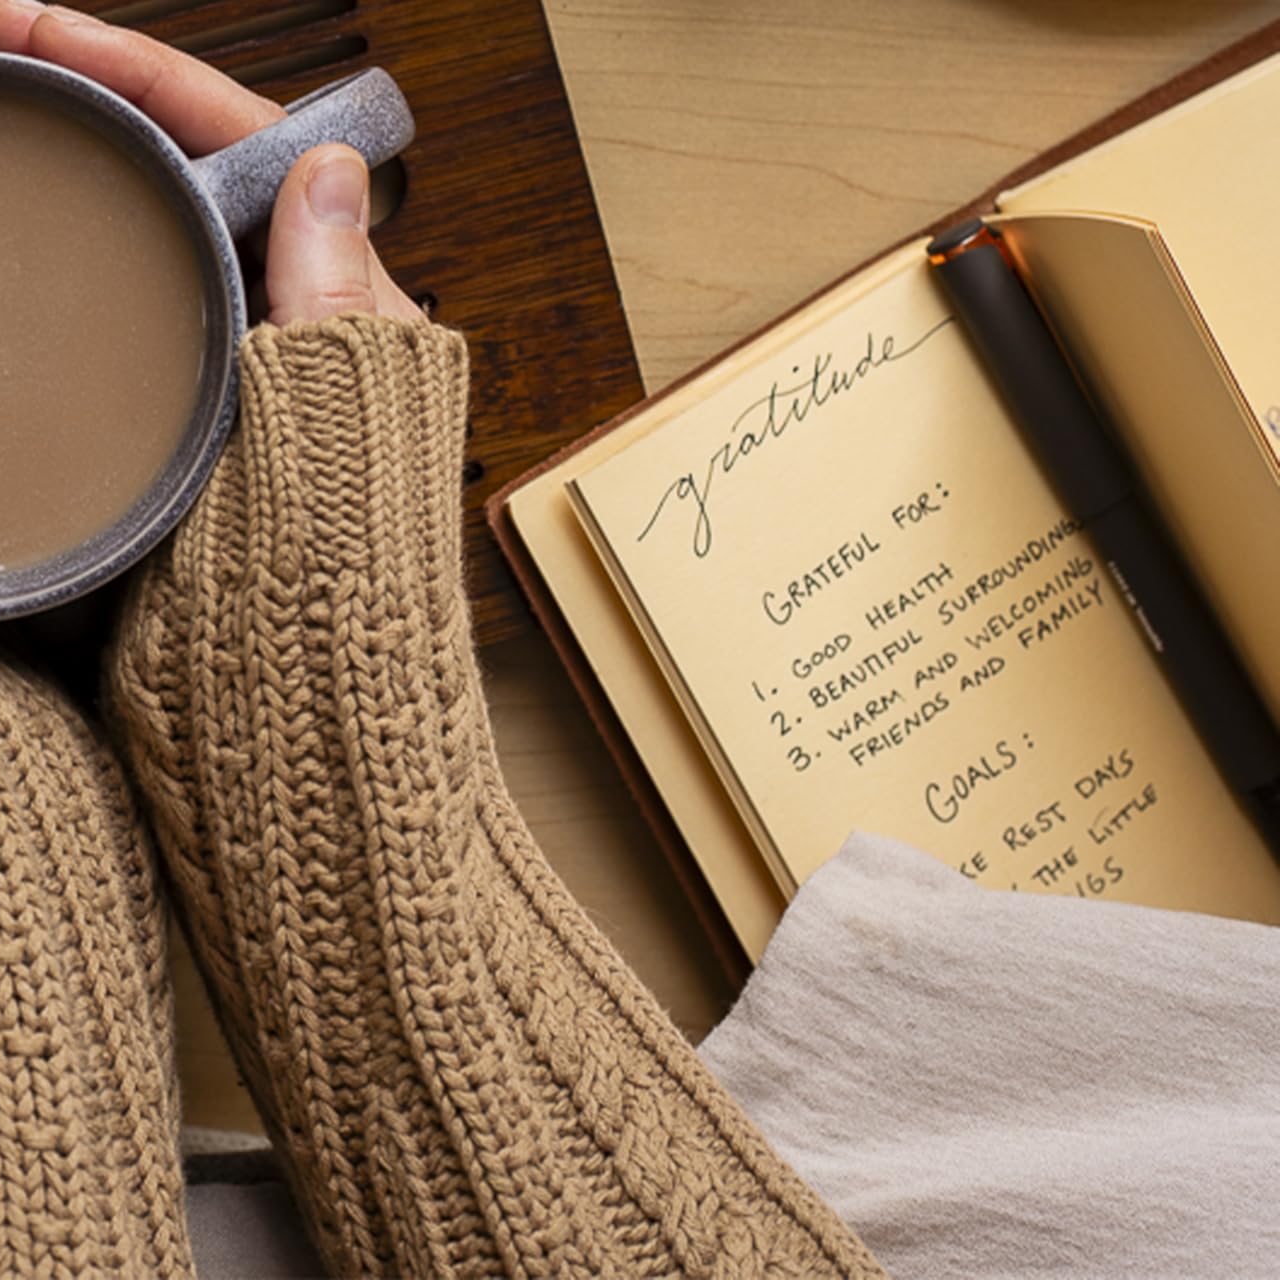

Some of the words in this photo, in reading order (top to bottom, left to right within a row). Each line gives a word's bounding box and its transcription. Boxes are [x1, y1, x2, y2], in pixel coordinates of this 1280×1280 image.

[637, 317, 953, 558] gratitude
[762, 532, 881, 626] GRATEFUL
[891, 482, 950, 530] FOR:
[751, 680, 779, 702] 1.
[791, 633, 852, 679] GOOD
[865, 562, 954, 631] HEALTH
[770, 710, 803, 737] 2.
[808, 629, 923, 709] BEAUTIFUL
[787, 745, 822, 773] 3.
[826, 688, 907, 742] WARM
[914, 651, 959, 689] AND
[964, 555, 1094, 651] WELCOMING
[848, 691, 950, 767] FRIENDS
[959, 655, 1006, 692] AND
[1018, 577, 1104, 650] FAMILY
[1002, 800, 1067, 852] REST
[1074, 748, 1135, 799] DAYS
[1032, 846, 1079, 887] THE
[1087, 783, 1158, 845] LITTLE
